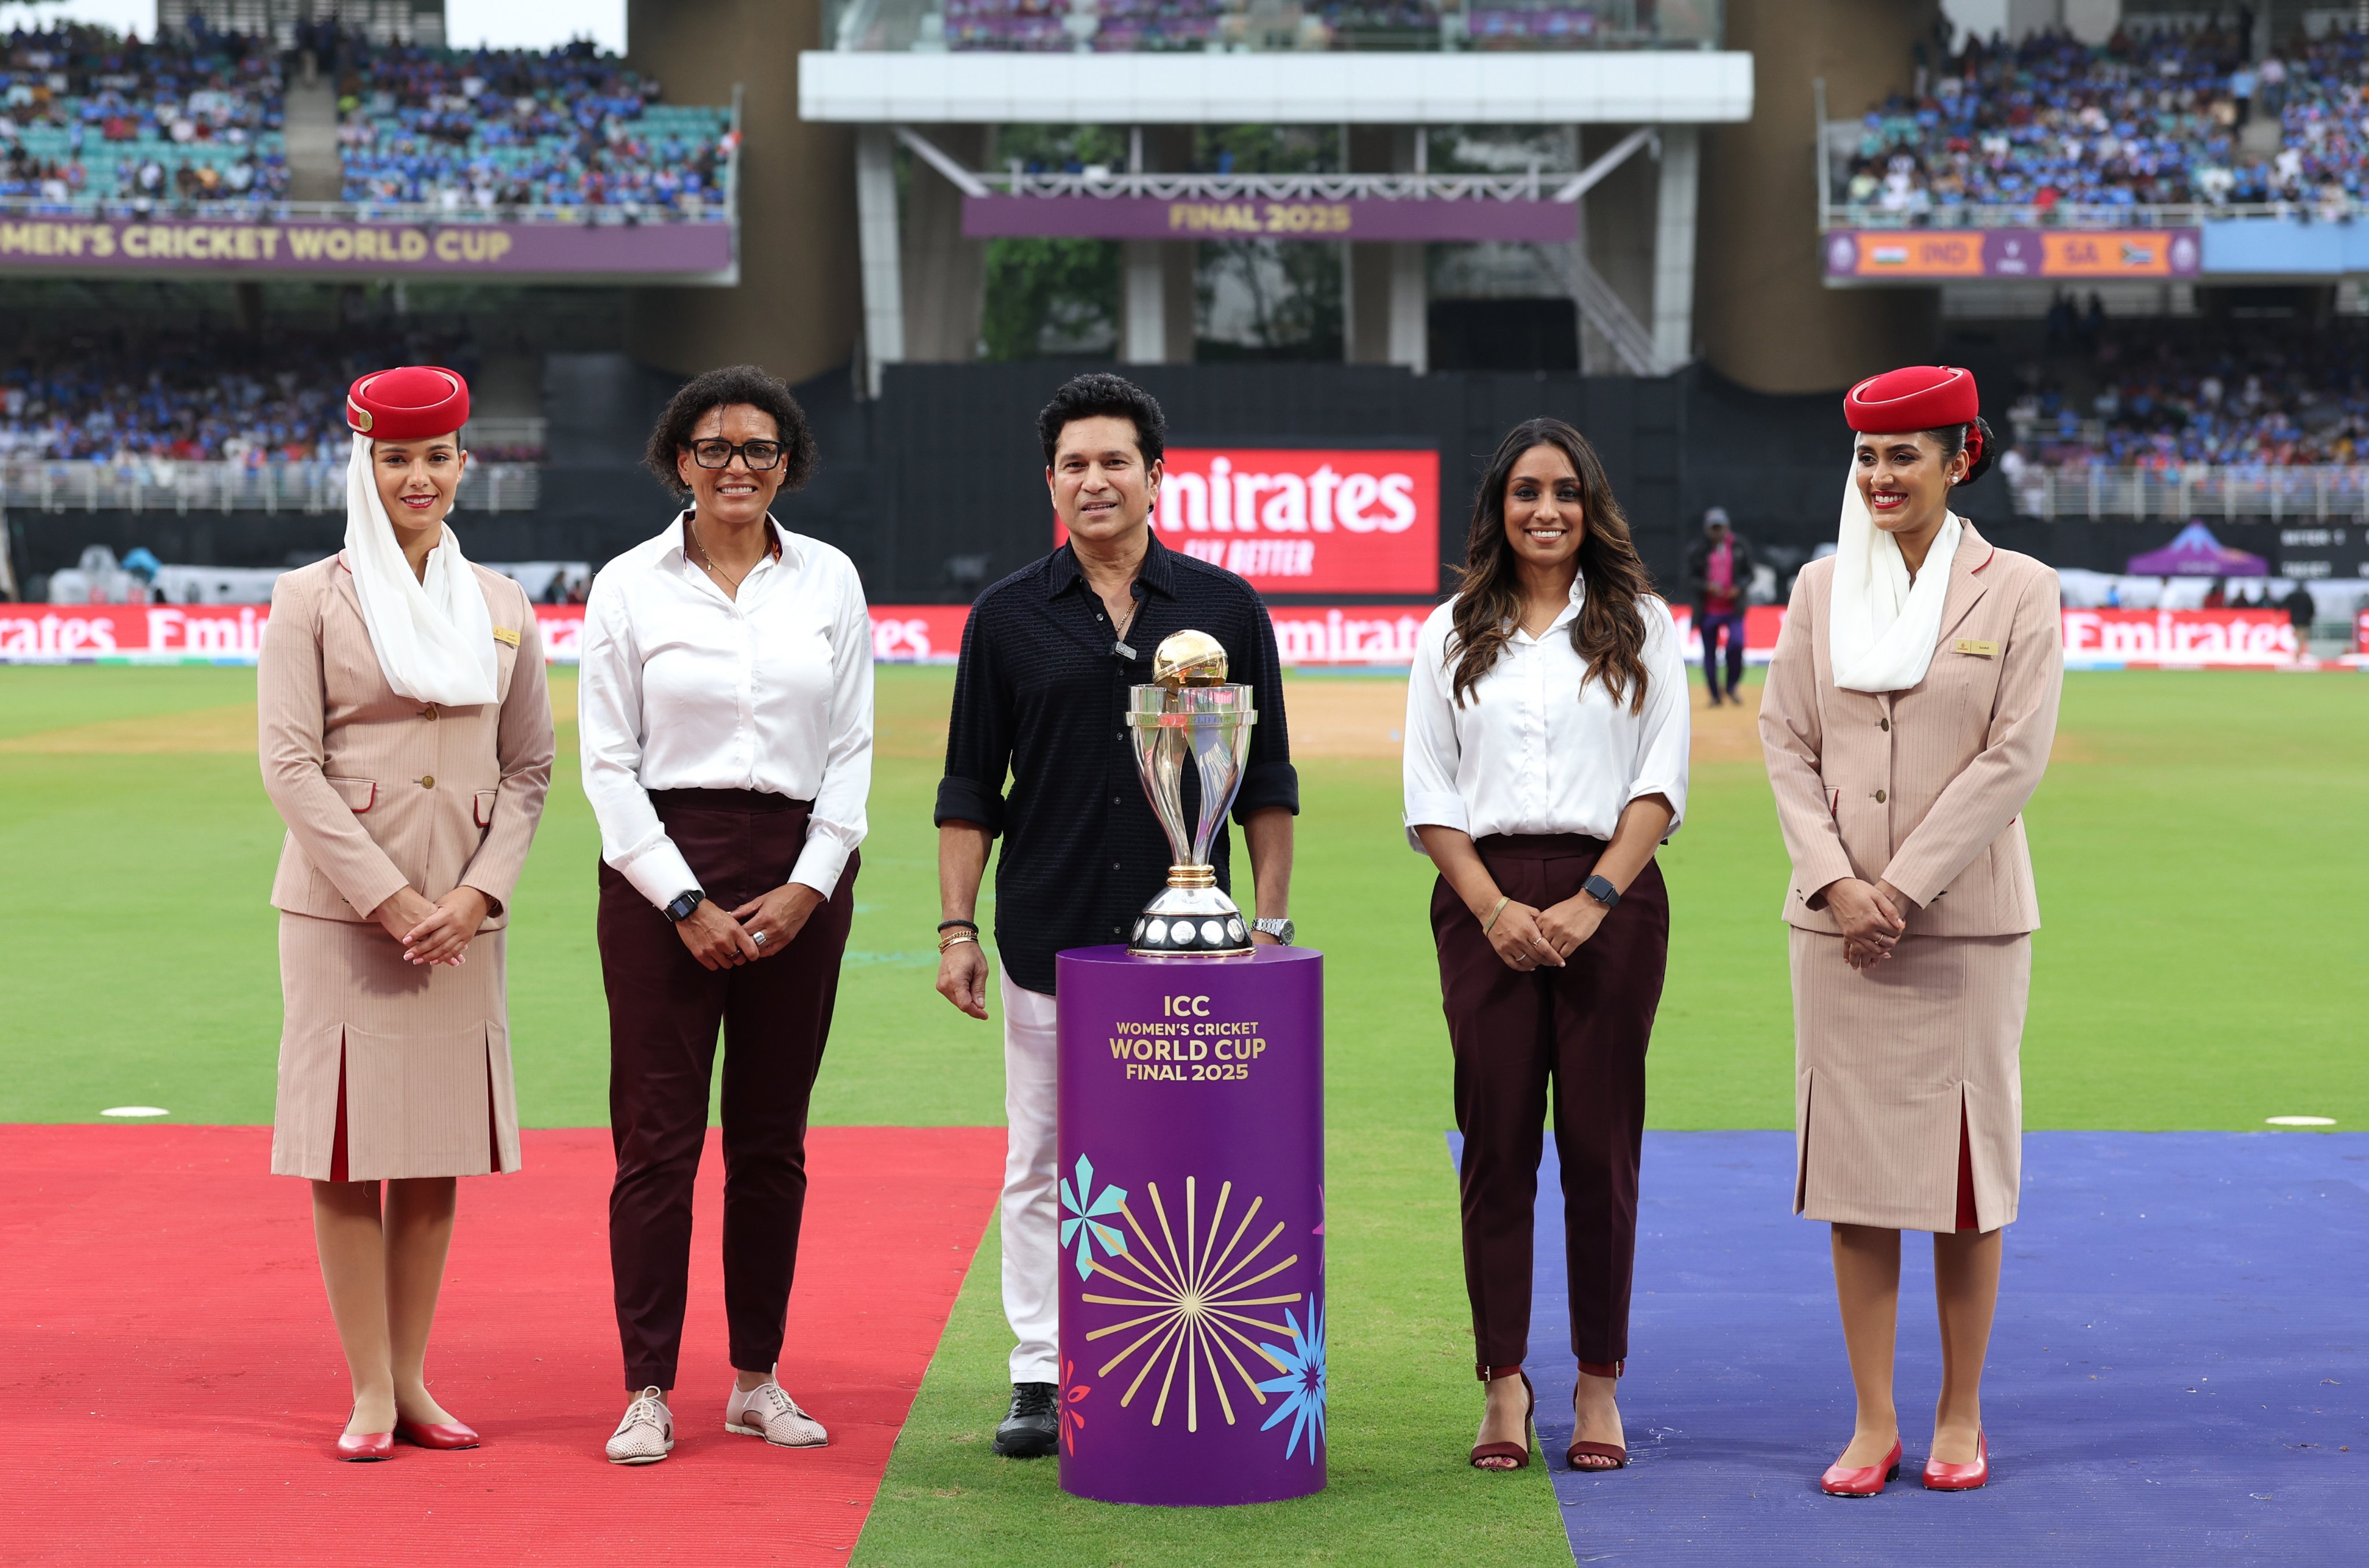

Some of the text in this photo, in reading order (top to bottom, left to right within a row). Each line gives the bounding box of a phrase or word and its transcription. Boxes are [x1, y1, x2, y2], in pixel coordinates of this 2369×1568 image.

[1169, 204, 1351, 231] FINAL 2025
[0, 222, 512, 263] MEN'S CRICKET WORLD CUP
[1149, 456, 1417, 533] mirates
[1226, 538, 1315, 577] BETTER
[146, 608, 268, 654] Emi
[1271, 609, 1424, 659] mirat
[1164, 995, 1210, 1017] ICC
[1116, 1022, 1259, 1036] WOMEN'S CRICKET
[1109, 1038, 1267, 1061] WORLD CUP
[1126, 1064, 1249, 1081] FINAL 2025
